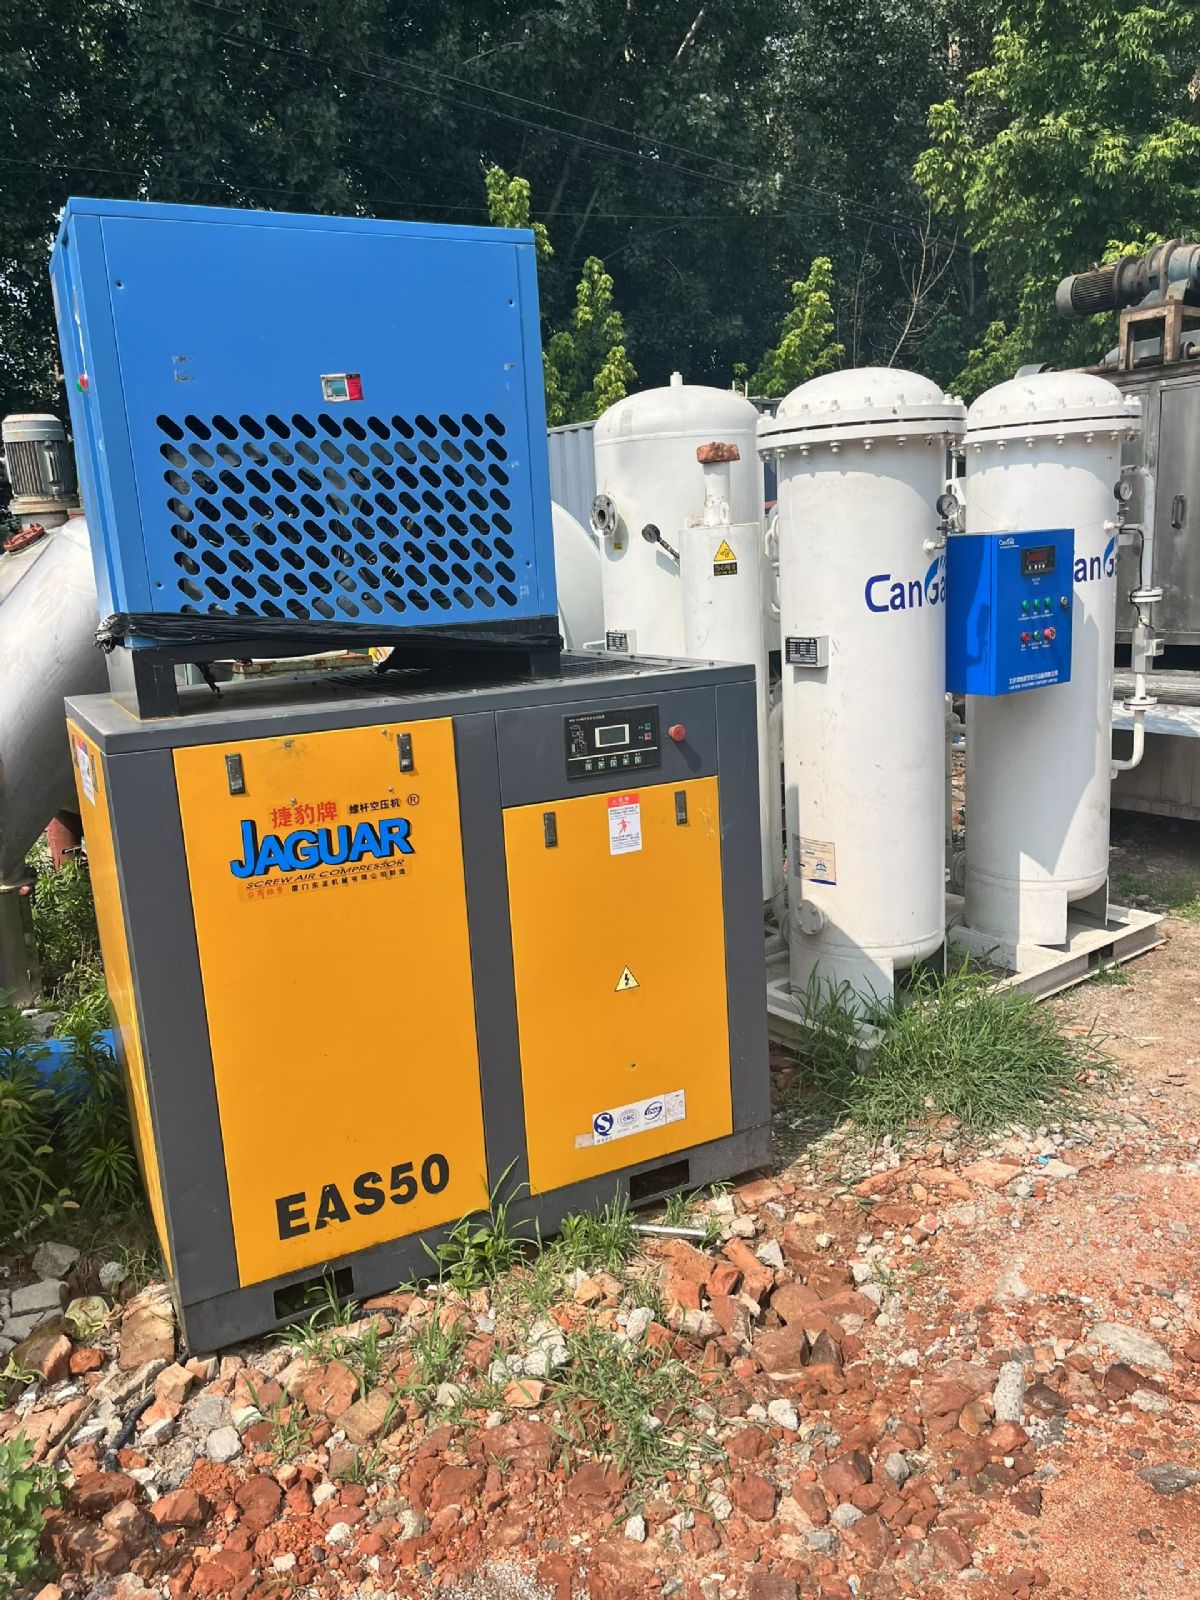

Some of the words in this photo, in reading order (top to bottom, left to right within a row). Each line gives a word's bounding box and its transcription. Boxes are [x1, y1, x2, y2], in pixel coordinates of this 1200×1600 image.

[271, 801, 338, 828] 捷豹牌
[348, 798, 401, 815] 螺杆空压机
[230, 817, 415, 879] JAGUAR
[246, 876, 293, 889] SCREW
[294, 872, 316, 882] AIR
[319, 859, 405, 878] COMPRESSOR
[275, 1153, 450, 1240] EAS50
